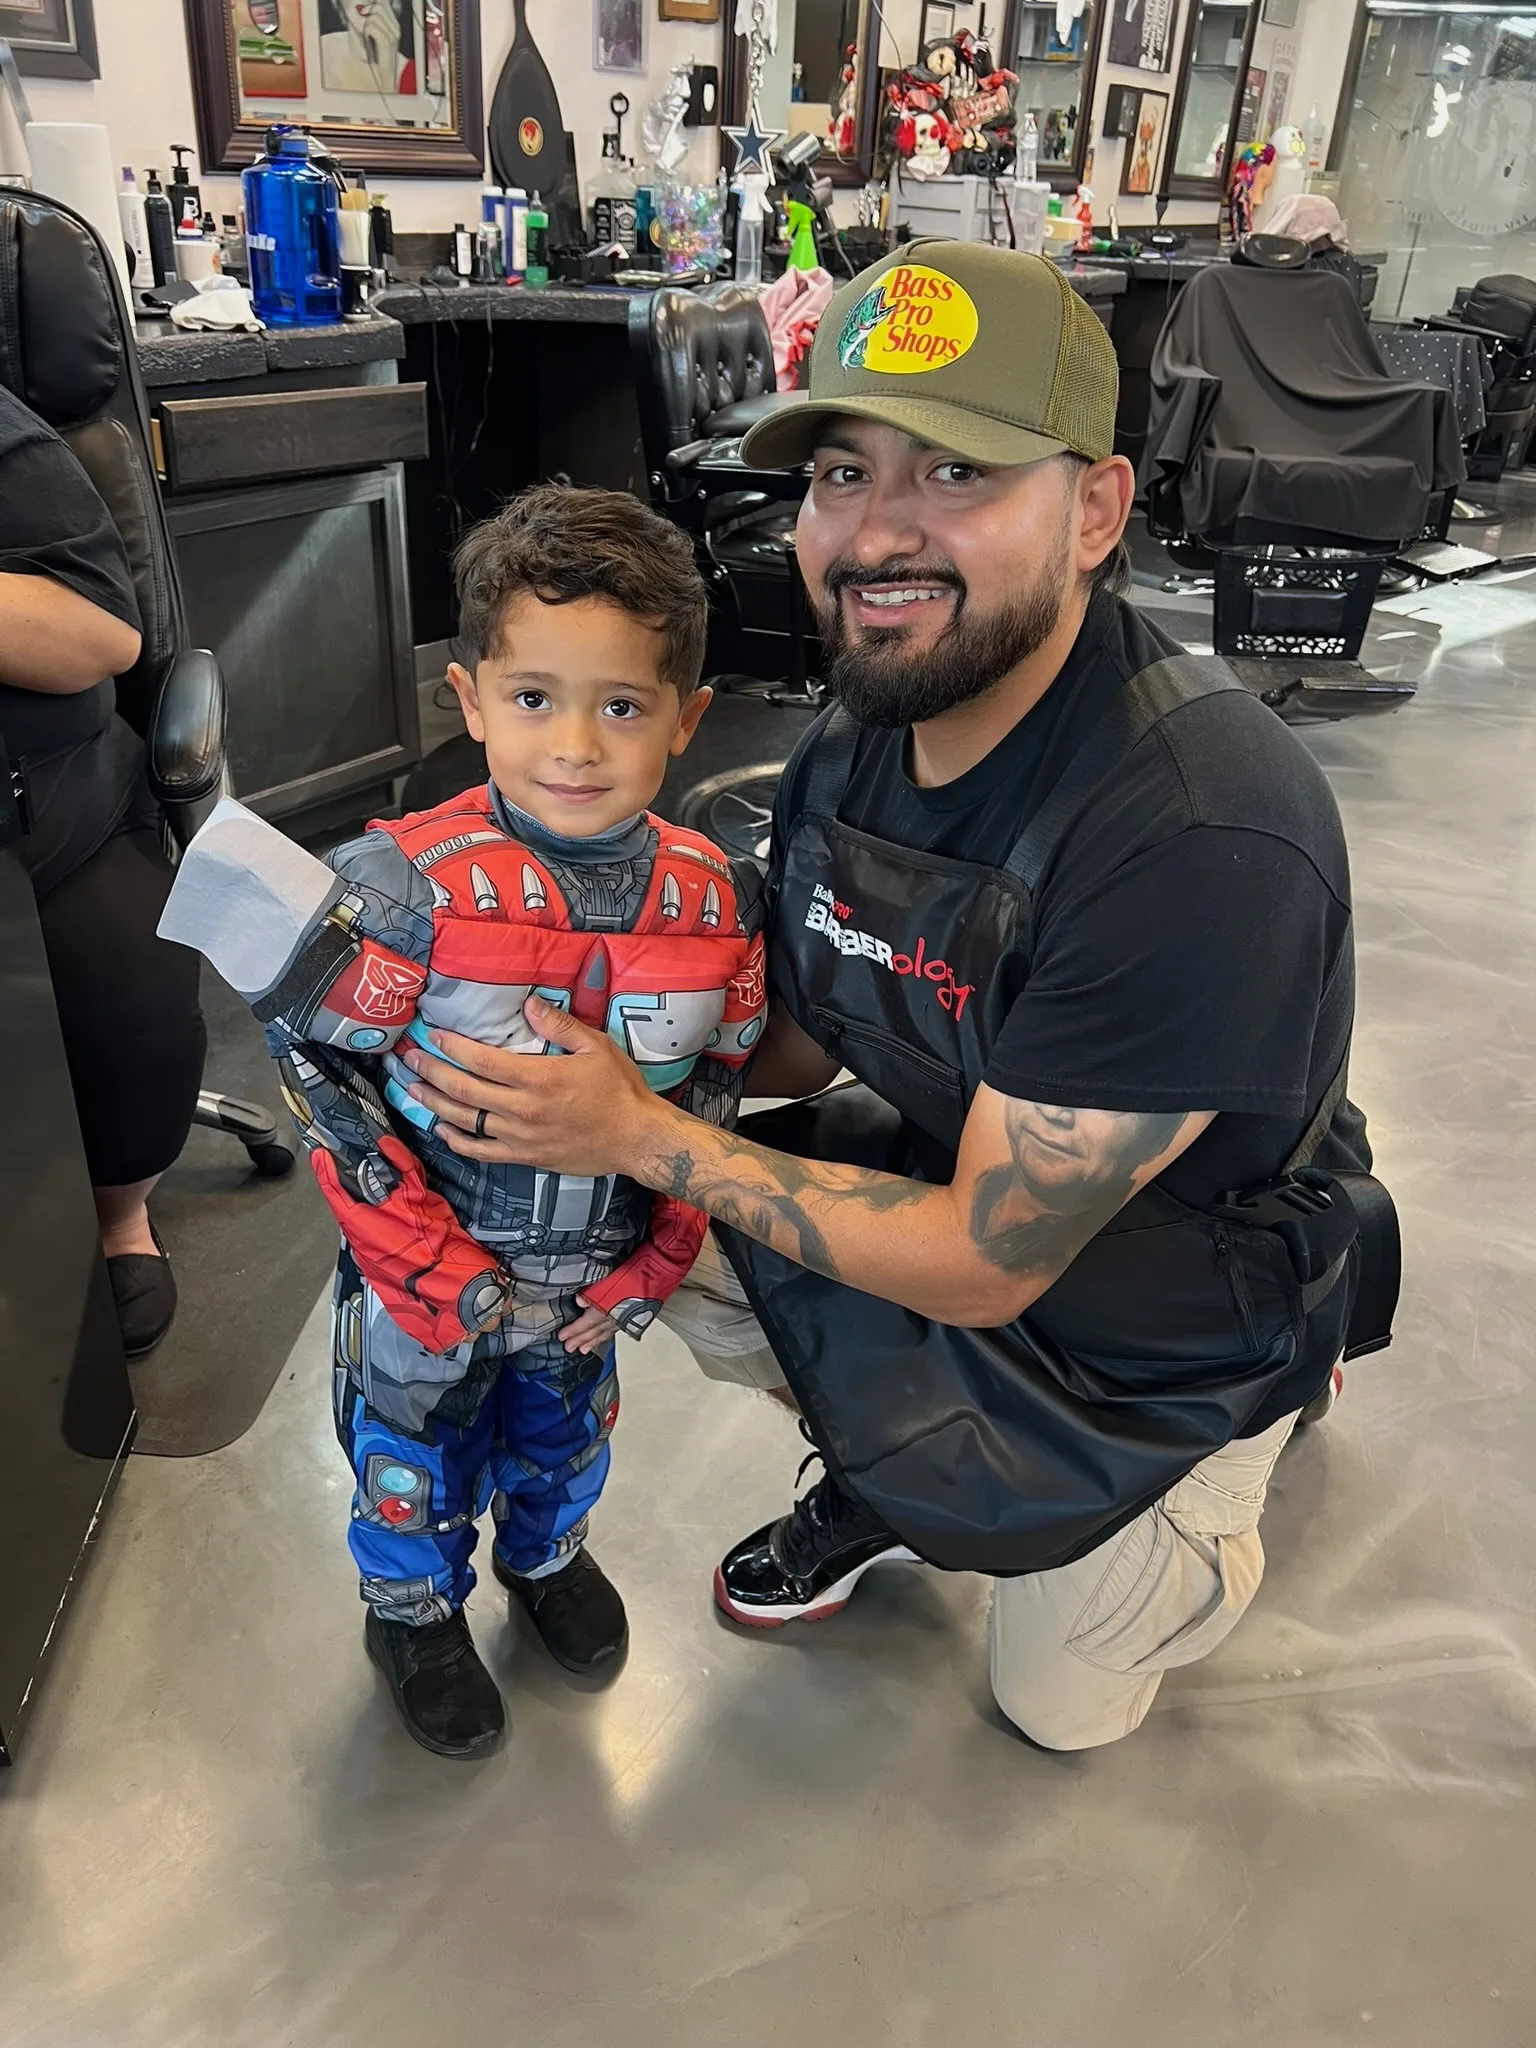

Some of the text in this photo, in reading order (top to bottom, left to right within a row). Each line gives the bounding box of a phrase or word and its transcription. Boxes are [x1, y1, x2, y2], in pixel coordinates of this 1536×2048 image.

[890, 269, 956, 302] Bass
[887, 299, 934, 327] Pro
[882, 325, 962, 363] Shops
